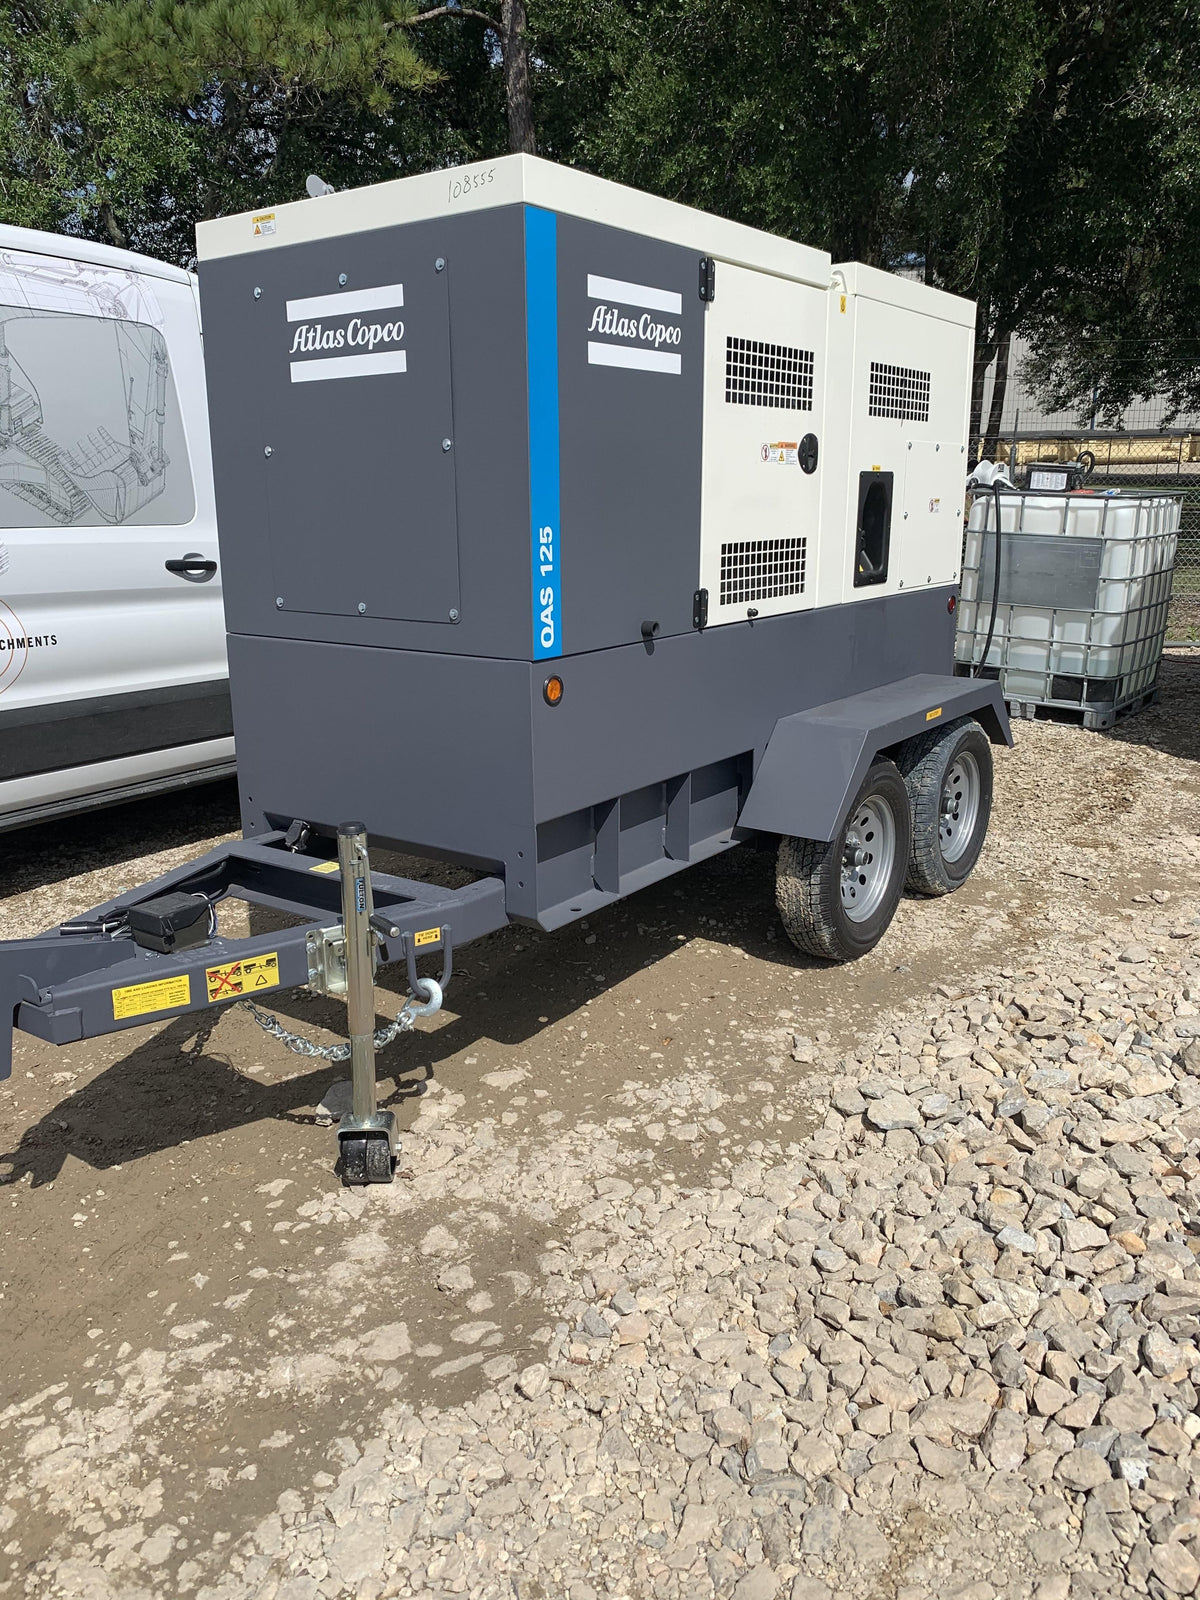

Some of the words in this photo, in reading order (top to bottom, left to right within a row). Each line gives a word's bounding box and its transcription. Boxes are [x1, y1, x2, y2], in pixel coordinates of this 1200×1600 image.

[448, 167, 497, 203] 108555
[289, 323, 345, 354] Atlas
[346, 318, 405, 350] Copco
[588, 305, 638, 339] Atlas
[638, 313, 682, 348] Copco
[539, 526, 553, 577] 125
[540, 586, 555, 648] QAS
